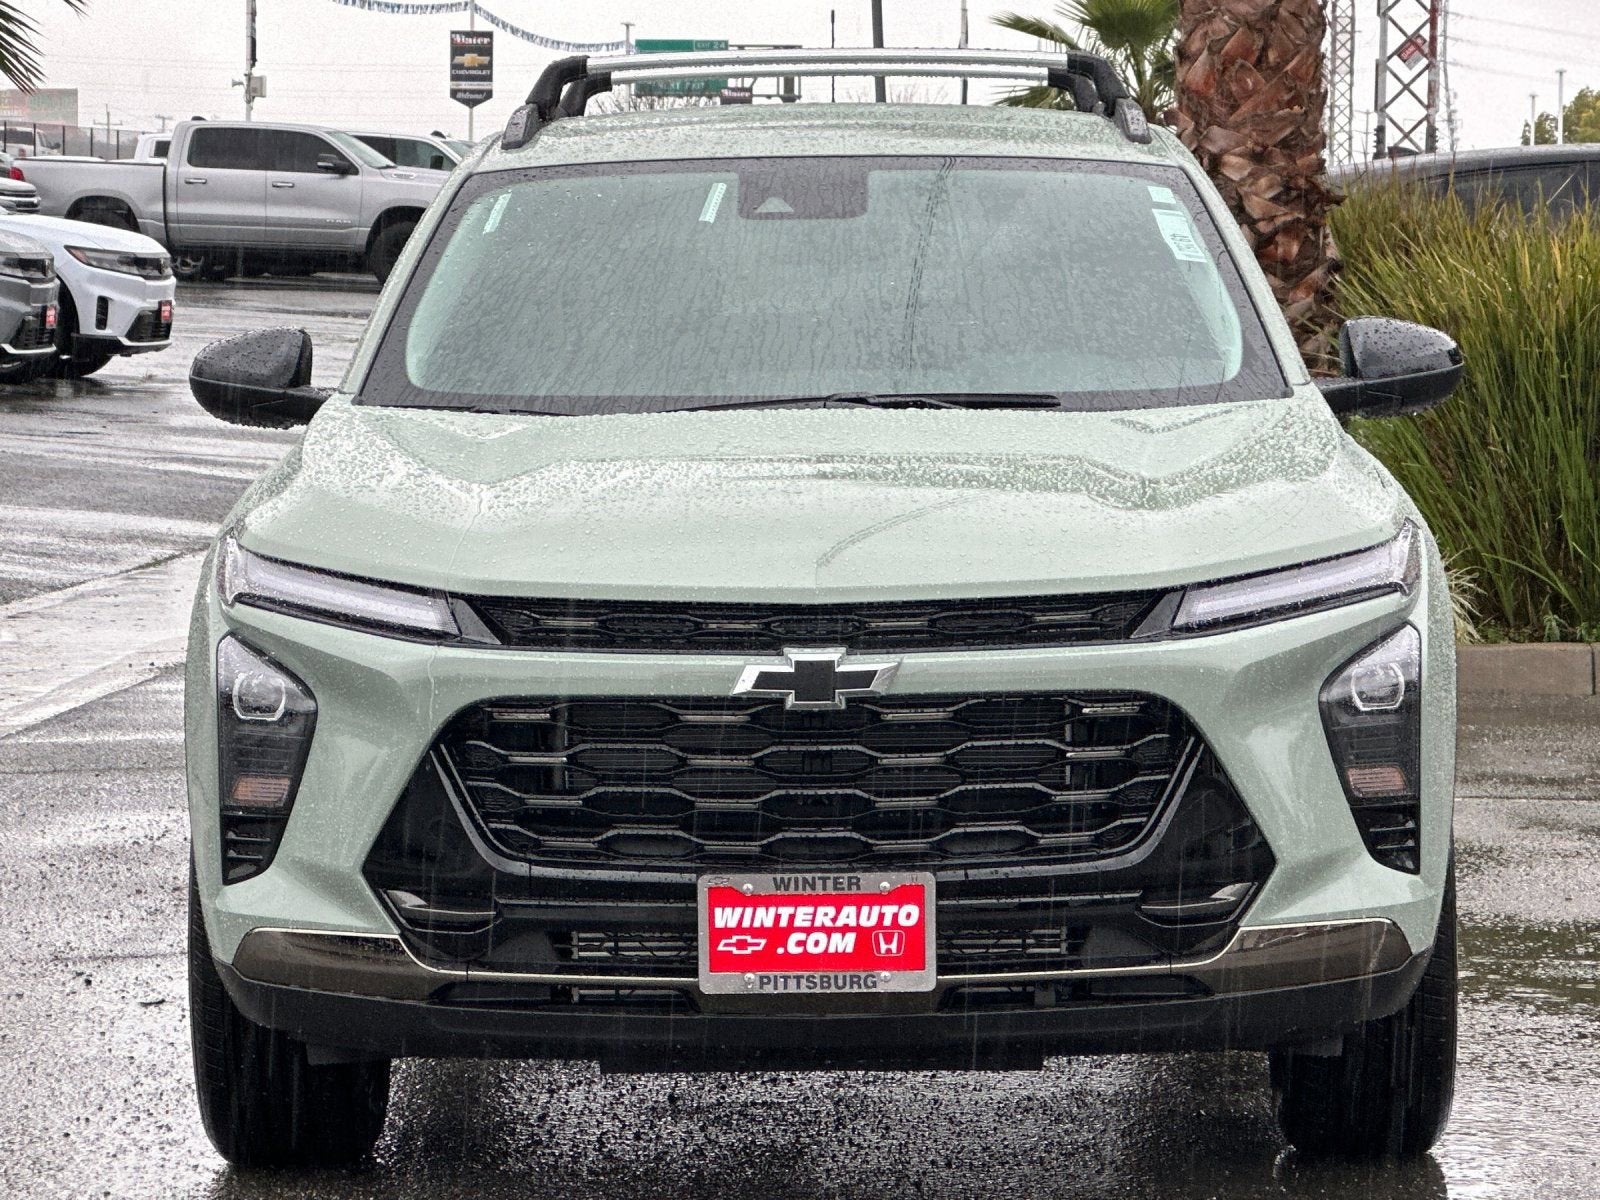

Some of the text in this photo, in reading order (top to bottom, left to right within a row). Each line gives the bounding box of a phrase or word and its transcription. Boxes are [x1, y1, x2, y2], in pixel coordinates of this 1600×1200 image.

[713, 41, 725, 49] 24
[772, 876, 862, 892] WINTER
[713, 904, 921, 929] WINTERAUTO
[776, 932, 857, 955] .COM
[758, 974, 878, 991] PITTSBURG
